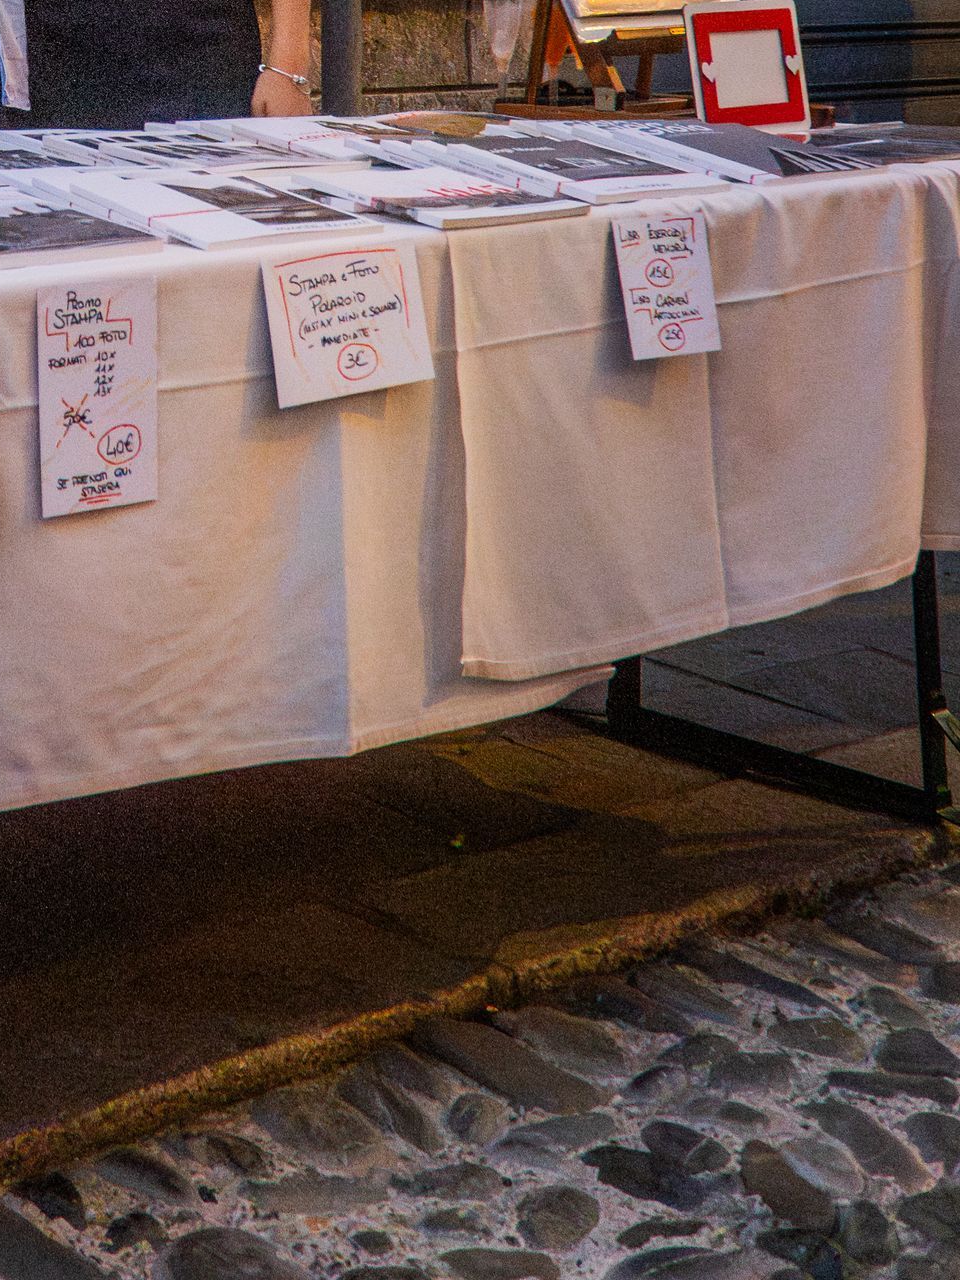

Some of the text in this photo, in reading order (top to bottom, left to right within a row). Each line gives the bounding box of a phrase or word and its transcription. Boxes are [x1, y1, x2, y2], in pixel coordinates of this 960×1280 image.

[289, 273, 337, 297] STAMPA
[345, 259, 379, 279] FOTO
[53, 309, 104, 330] STAMPA
[74, 330, 127, 349] 100 FOTO
[344, 350, 368, 369] 3€
[106, 433, 133, 457] 40€
[81, 482, 120, 498] STASERA
